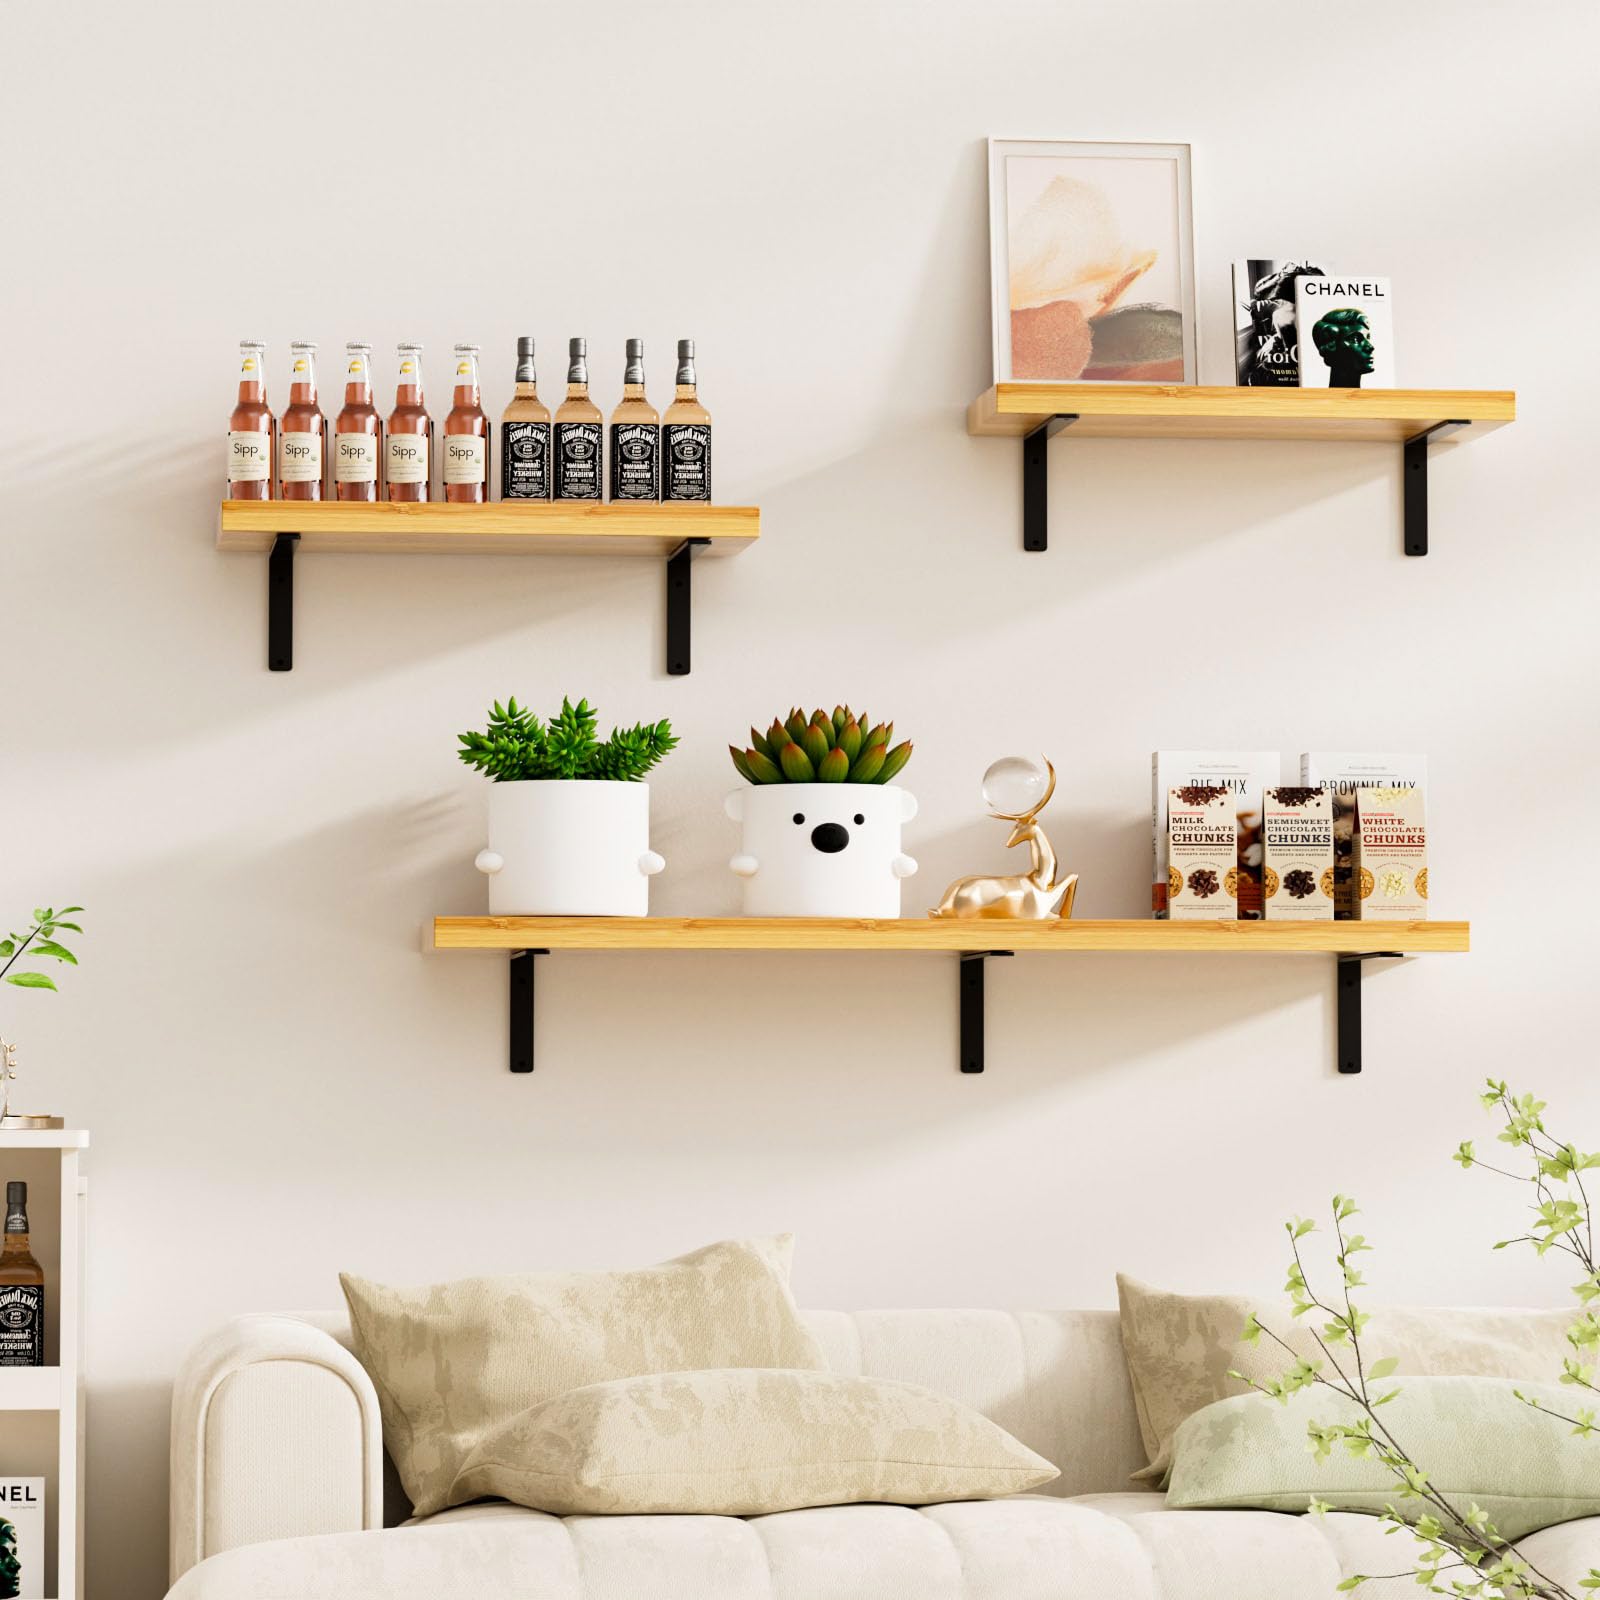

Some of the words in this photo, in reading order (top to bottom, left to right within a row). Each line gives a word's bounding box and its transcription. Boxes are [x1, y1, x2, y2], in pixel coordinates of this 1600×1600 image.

[1305, 282, 1384, 296] CHANEL
[234, 442, 258, 458] Sipp
[285, 444, 310, 458] Sipp
[340, 444, 366, 459] Sipp
[392, 445, 416, 460] Sipp
[449, 446, 474, 460] Sipp
[1172, 834, 1234, 842] CHUNKS
[1268, 834, 1330, 842] CHUNKS
[1363, 834, 1425, 843] CHUNKS
